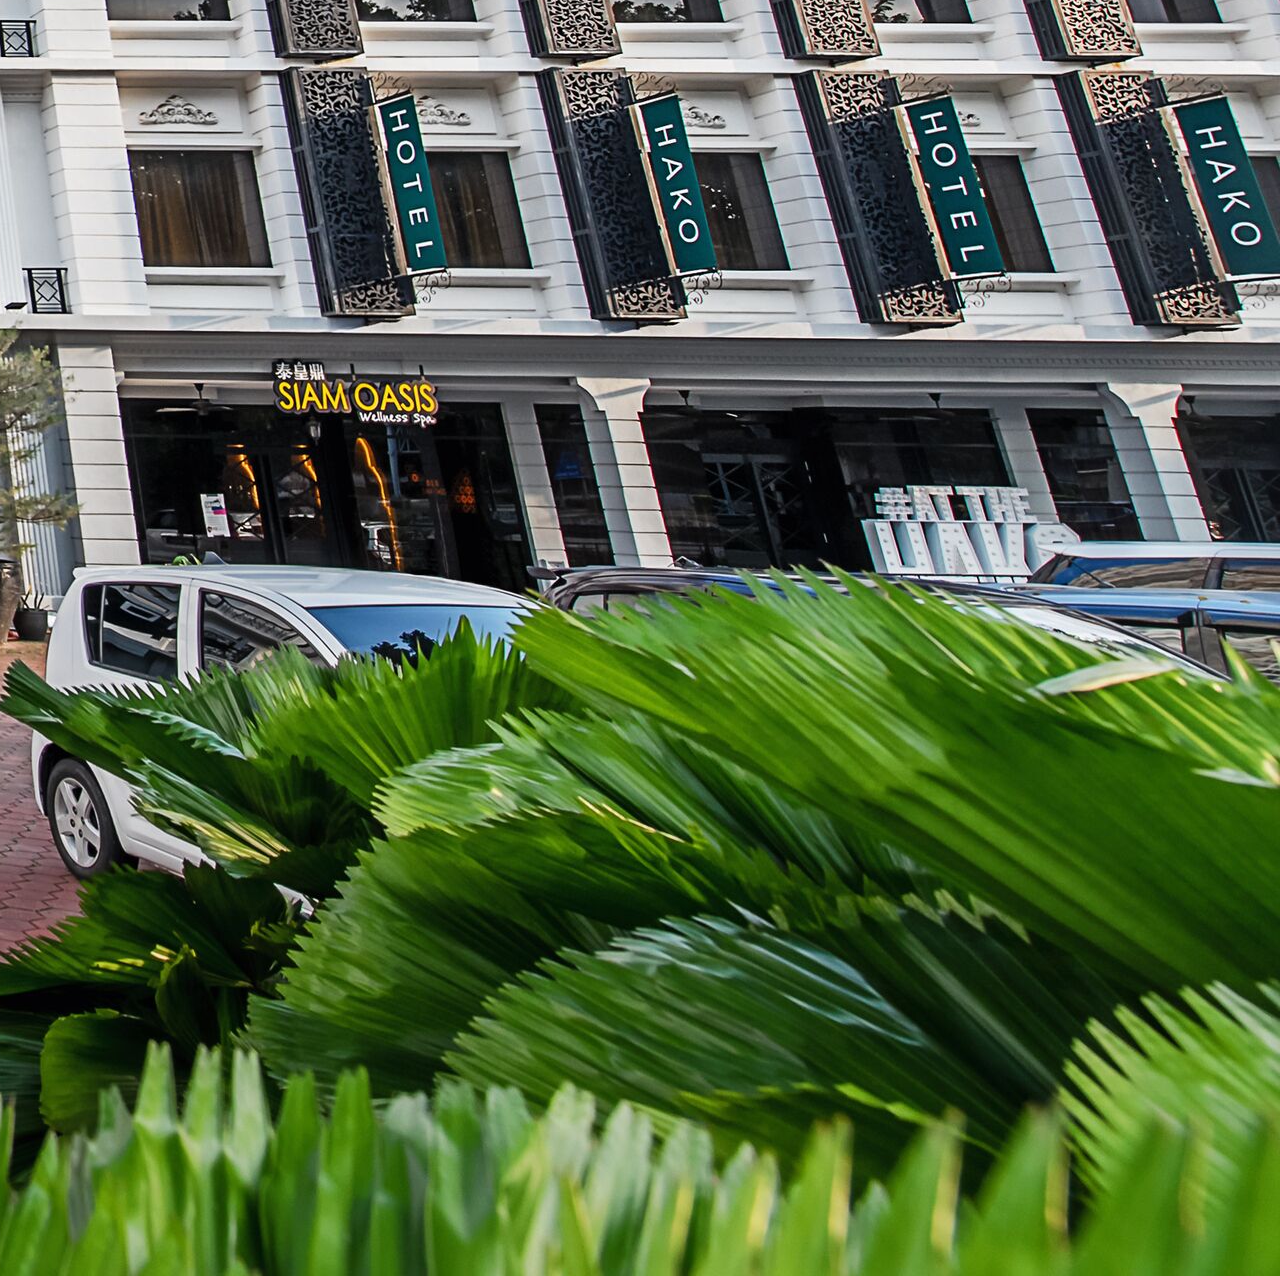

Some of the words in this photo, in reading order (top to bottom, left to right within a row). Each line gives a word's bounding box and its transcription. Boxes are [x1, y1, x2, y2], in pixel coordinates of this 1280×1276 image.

[388, 108, 434, 258] HOTEL
[654, 124, 701, 244] HAKO
[920, 111, 985, 262] HOTEL
[1195, 125, 1263, 247] HAKO
[275, 361, 325, 381] 泰皇鼎
[278, 381, 350, 412] SIAM
[353, 382, 438, 413] OASIS
[359, 411, 409, 424] Wellness
[413, 412, 437, 429] Spa
[955, 485, 1038, 522] THE
